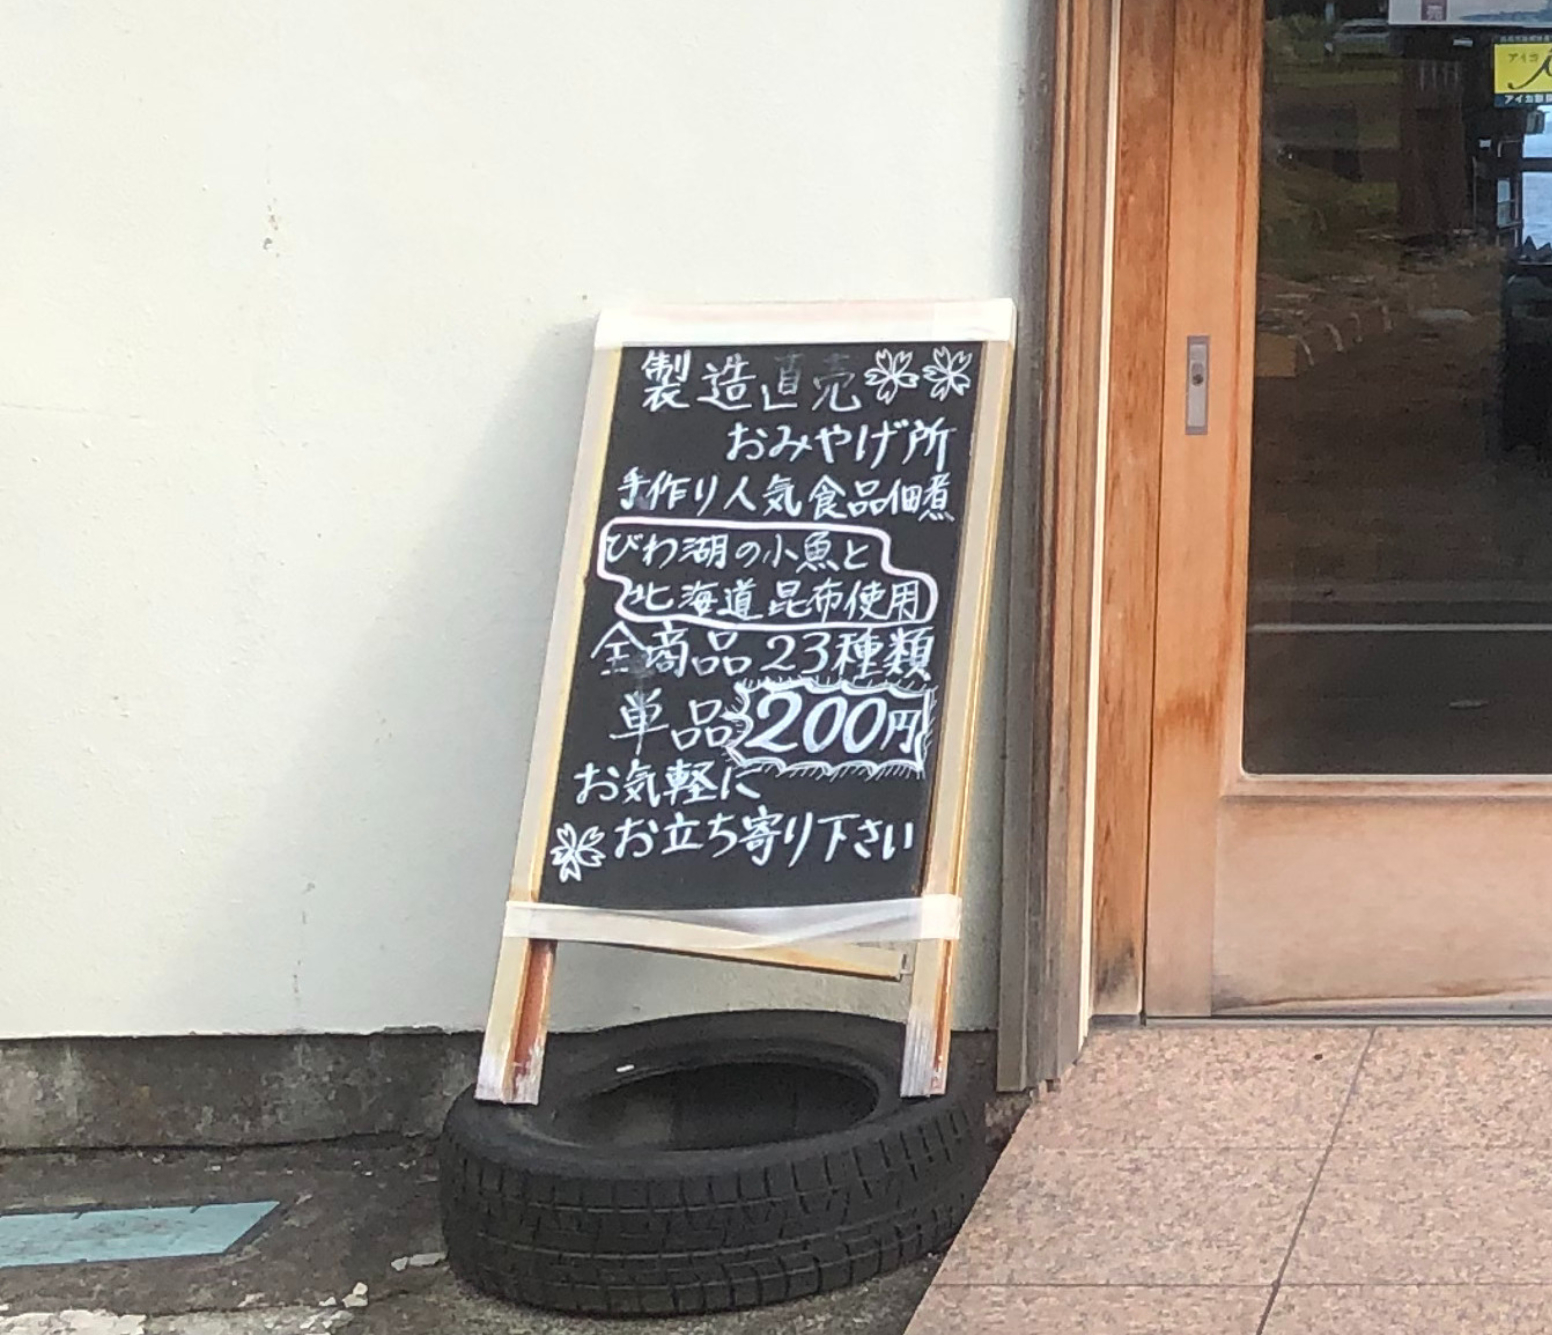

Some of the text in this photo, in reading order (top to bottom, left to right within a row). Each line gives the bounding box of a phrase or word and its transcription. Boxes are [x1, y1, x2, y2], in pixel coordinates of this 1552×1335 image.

[640, 348, 863, 412] 製造直売
[725, 416, 958, 472] おみやげ所
[616, 466, 955, 523] 手作り人気食品佃煮
[605, 532, 871, 575] びわ湖の小魚と
[625, 578, 922, 624] 北海道昆布使用
[744, 689, 925, 756] 200円
[573, 761, 762, 808] お気軽に
[613, 805, 915, 868] お立ち寄り下さい
